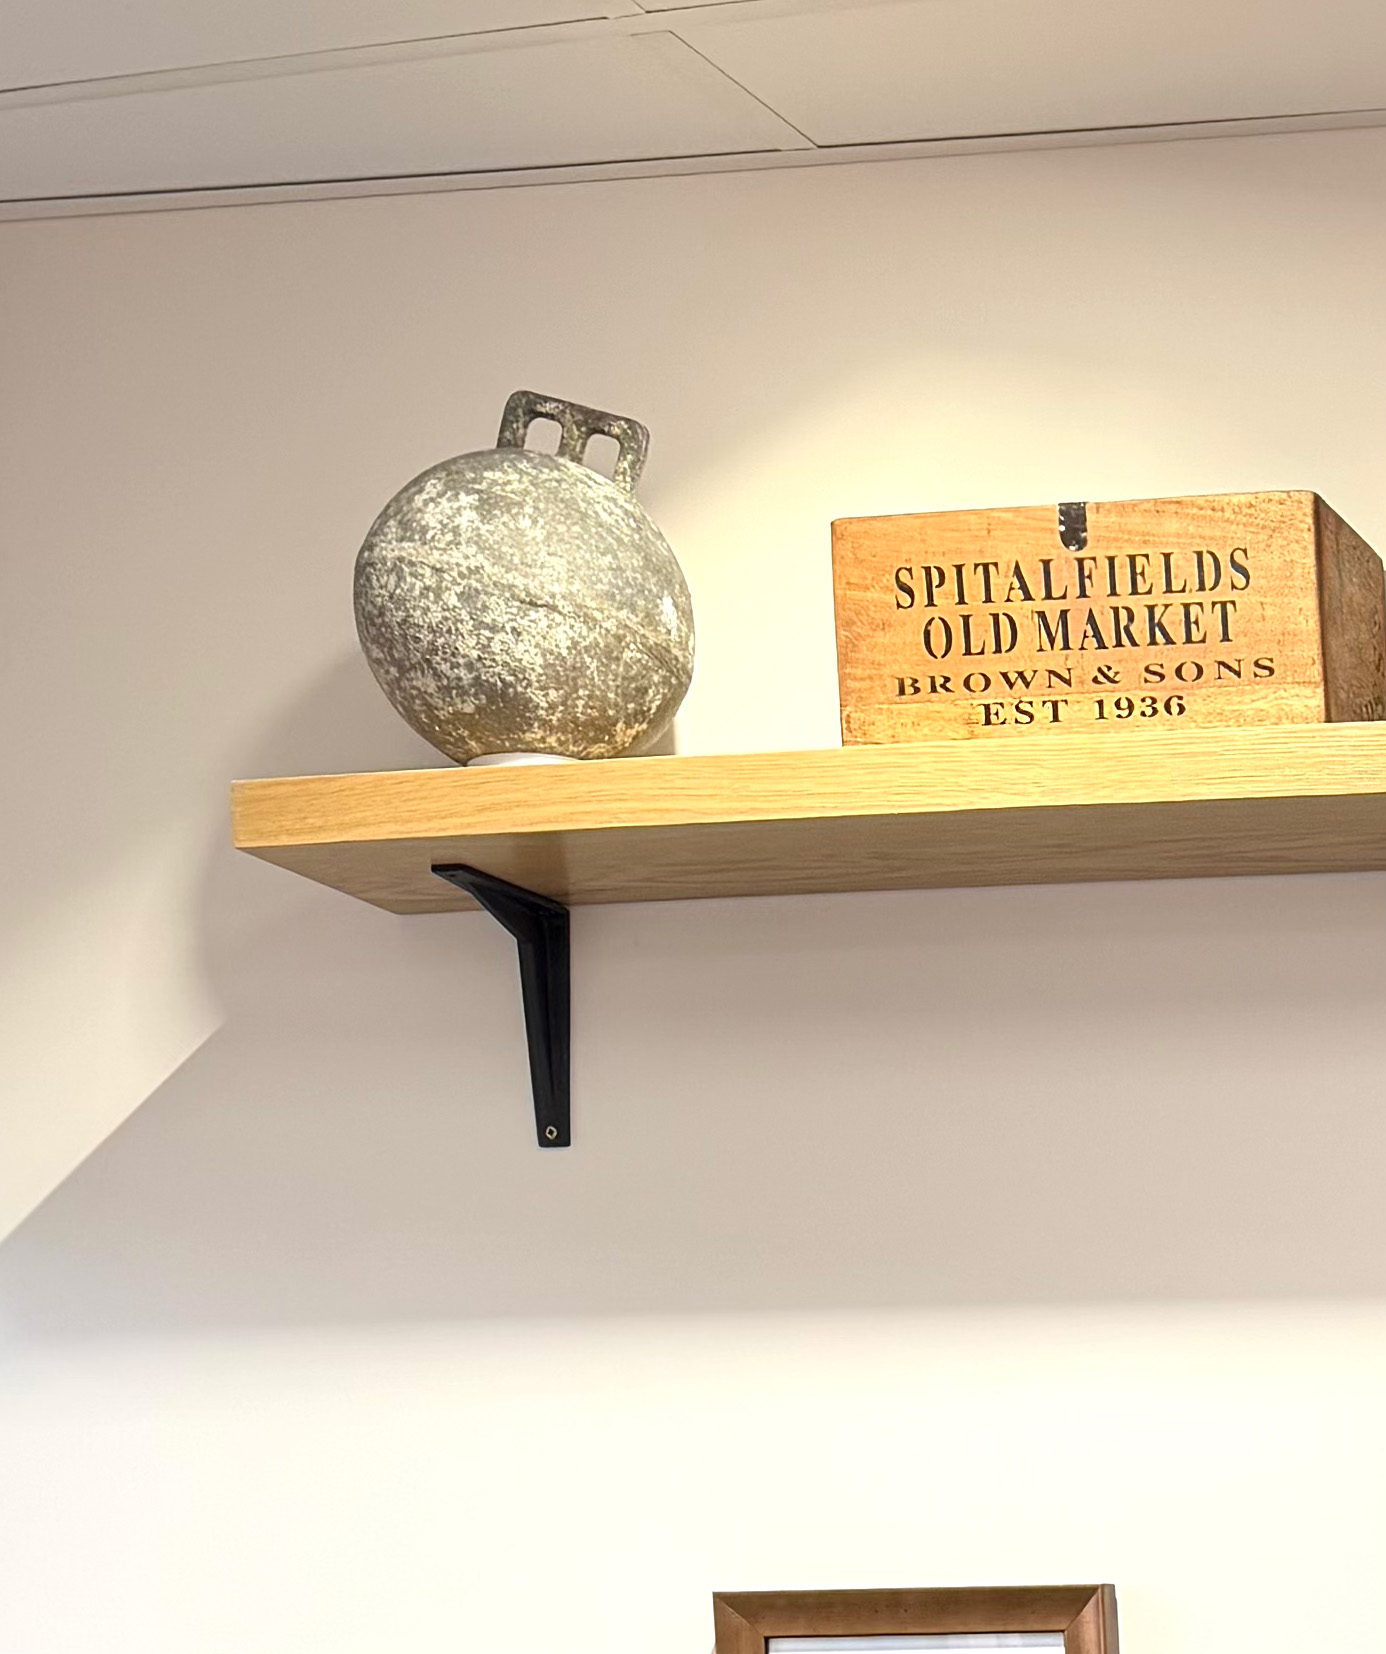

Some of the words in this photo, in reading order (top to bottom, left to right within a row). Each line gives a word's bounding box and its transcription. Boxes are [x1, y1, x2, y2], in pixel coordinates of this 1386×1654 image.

[894, 547, 1250, 609] SPITALFIELDS
[923, 612, 1017, 659] OLD
[1035, 601, 1236, 653] MARKET
[895, 667, 1071, 696] BROWN
[1091, 664, 1120, 685] &
[1143, 657, 1274, 683] SONS
[981, 699, 1068, 726] EST
[1094, 694, 1186, 720] 1936
